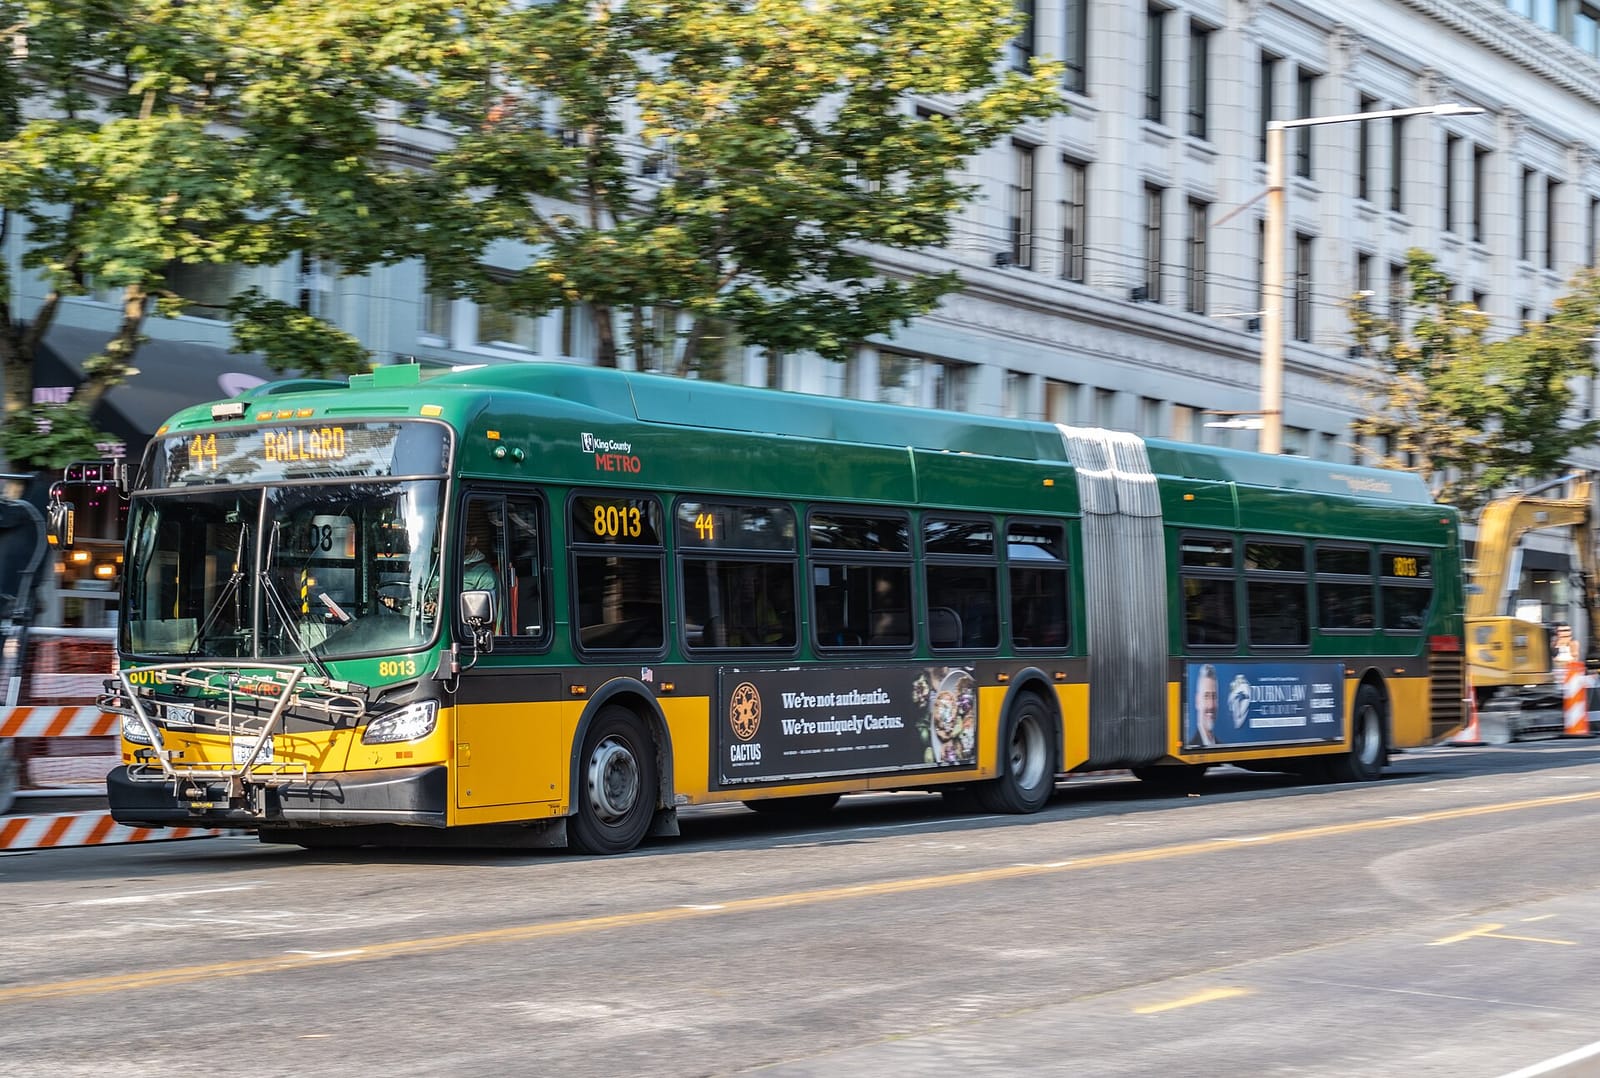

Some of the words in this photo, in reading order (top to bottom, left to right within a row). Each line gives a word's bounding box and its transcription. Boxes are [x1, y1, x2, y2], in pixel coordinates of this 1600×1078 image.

[189, 433, 218, 470] 44
[263, 426, 345, 462] BALLARD
[594, 438, 609, 452] King
[609, 440, 631, 454] County
[595, 453, 641, 473] METRO
[594, 505, 641, 537] 8013
[695, 513, 713, 540] 44
[379, 661, 416, 676] 8013
[781, 692, 816, 708] We're
[816, 692, 836, 707] not
[836, 687, 891, 706] authentic.
[781, 718, 816, 735] We're
[816, 715, 864, 736] uniquely
[863, 714, 905, 730] Cactus.
[730, 743, 761, 762] CACTUS
